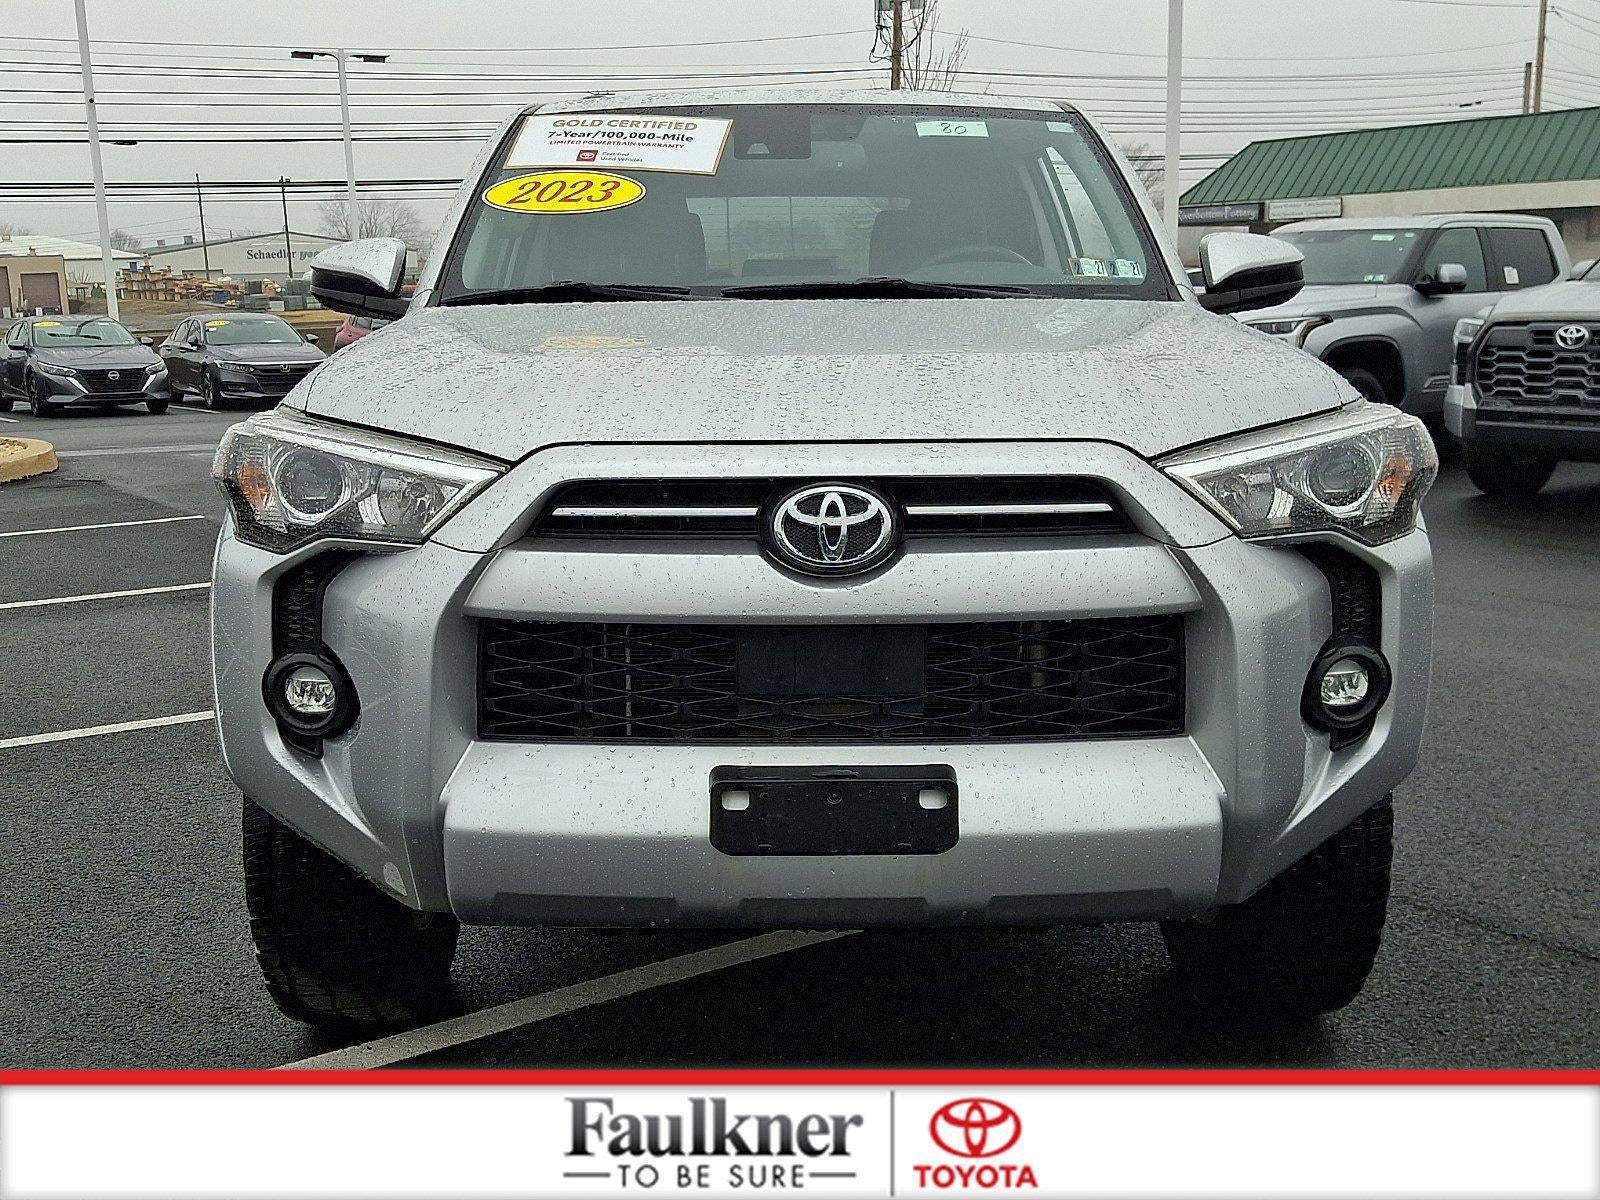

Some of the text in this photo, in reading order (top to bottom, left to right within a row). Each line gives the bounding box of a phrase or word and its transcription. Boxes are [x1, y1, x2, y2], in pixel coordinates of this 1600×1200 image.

[553, 119, 698, 131] GOLD CERTIFIED
[548, 130, 694, 143] 7-Year/100,000-Mile
[506, 180, 622, 205] 2023
